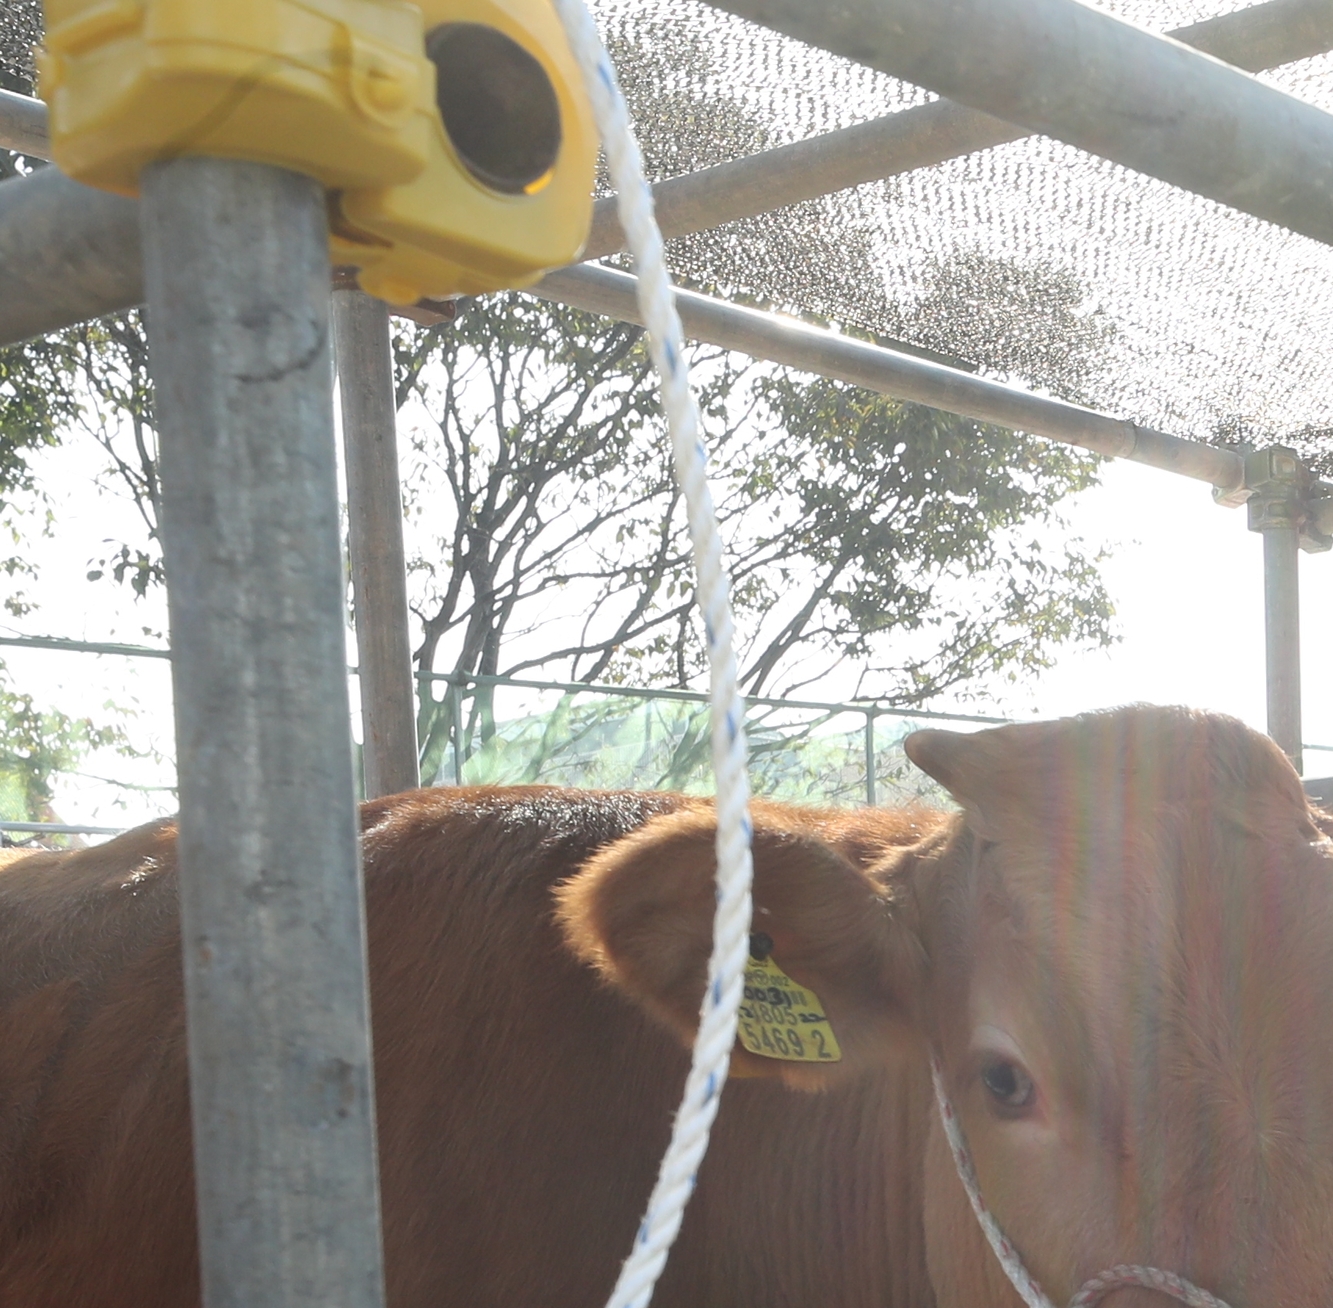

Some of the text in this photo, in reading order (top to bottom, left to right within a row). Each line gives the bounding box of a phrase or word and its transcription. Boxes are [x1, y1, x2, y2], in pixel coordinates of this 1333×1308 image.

[752, 1001, 798, 1026] 1805
[743, 1022, 832, 1058] 5469 2
